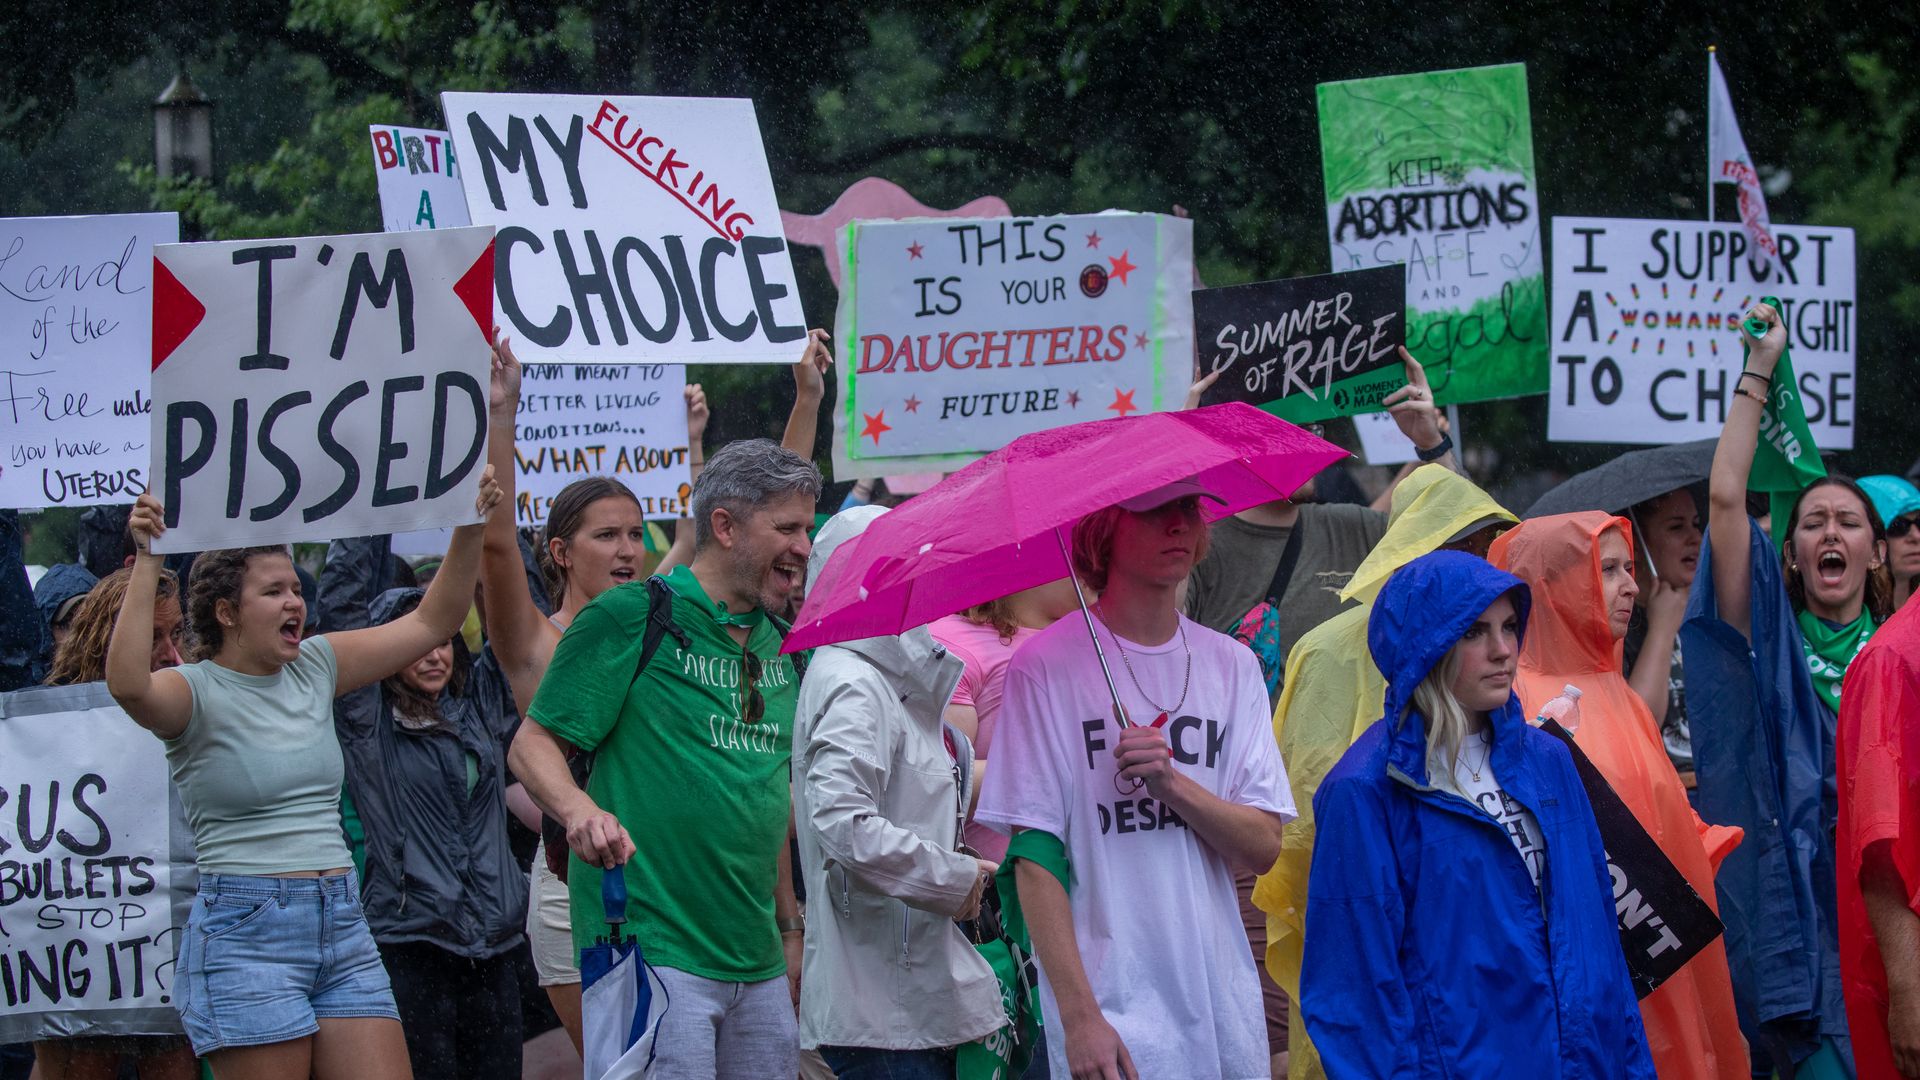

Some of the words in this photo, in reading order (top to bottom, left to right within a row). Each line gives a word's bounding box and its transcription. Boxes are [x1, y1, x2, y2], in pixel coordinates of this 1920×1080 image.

[466, 111, 588, 211] MY
[588, 100, 755, 241] FUCKING
[1388, 157, 1443, 188] KEEP
[416, 189, 436, 229] A
[1334, 182, 1529, 243] ABORTIONS
[948, 220, 1066, 266] THIS
[1374, 230, 1489, 283] SAFE
[1572, 228, 1607, 273] I
[1642, 228, 1833, 286] SUPPORT
[0, 235, 145, 302] Land
[495, 226, 806, 348] CHOICE
[1422, 287, 1461, 300] AND
[232, 244, 414, 371] I'M
[913, 276, 962, 317] IS
[1001, 277, 1066, 305] YOUR
[1562, 290, 1599, 342] A
[1621, 309, 1741, 331] WOMANS
[1779, 298, 1853, 353] IGHT
[30, 305, 56, 360] of
[65, 302, 119, 343] the
[856, 324, 1128, 374] DAUGHTERS
[1211, 292, 1352, 373] SUMMER
[1405, 281, 1533, 392] egal
[575, 364, 631, 381] MEANT
[637, 364, 665, 380] TO
[1244, 357, 1277, 392] OF
[1282, 312, 1397, 402] RAGE
[0, 370, 104, 424] Free
[595, 391, 661, 411] LIVING
[940, 388, 1059, 419] FUTURE
[1352, 378, 1404, 395] WOMEN'S
[1353, 390, 1401, 407] MAR
[1557, 356, 1623, 406] TO
[1650, 368, 1852, 427] CHSE
[11, 443, 46, 468] you
[56, 438, 110, 459] have
[123, 440, 145, 452] a
[164, 371, 488, 528] PISSED
[515, 445, 606, 475] WHAT
[615, 445, 689, 475] ABOUT
[42, 467, 148, 503] UTERUS
[752, 658, 789, 687] RTH
[709, 714, 779, 754] SLAVERY
[1082, 714, 1227, 769] FCK
[1097, 798, 1188, 835] DESA
[0, 856, 155, 905] BULLETS
[1605, 852, 1682, 959] ON'T
[37, 903, 147, 932] STOP
